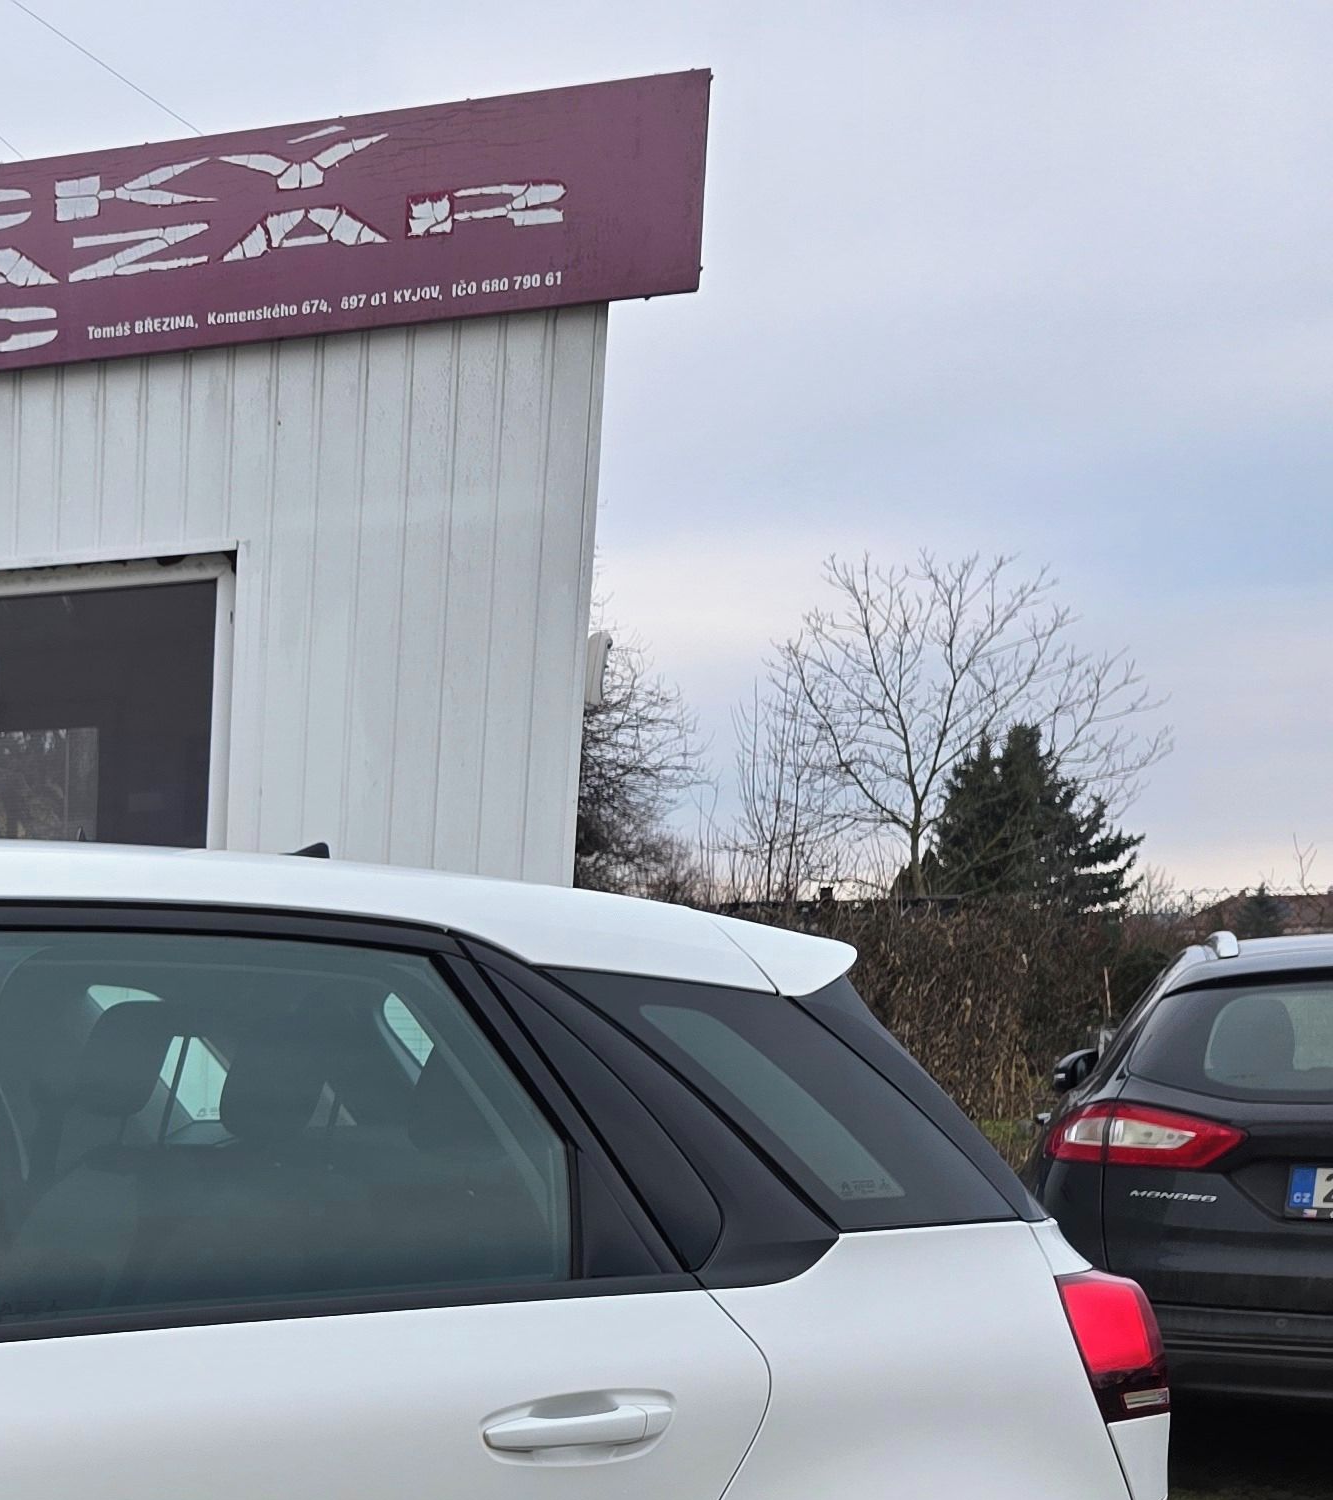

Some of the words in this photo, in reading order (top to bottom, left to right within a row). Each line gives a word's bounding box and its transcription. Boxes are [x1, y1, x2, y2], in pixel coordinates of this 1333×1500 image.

[87, 321, 131, 340] Tomáš
[207, 303, 298, 326] Komenského
[301, 298, 332, 315] 674,
[370, 291, 388, 305] 01
[393, 284, 443, 304] KYJOV,
[451, 279, 477, 298] IČO
[481, 276, 509, 293] 680
[512, 273, 541, 289] 790
[545, 270, 563, 287] 61
[1129, 1188, 1218, 1204] MONDEO
[1293, 1191, 1311, 1204] CZ
